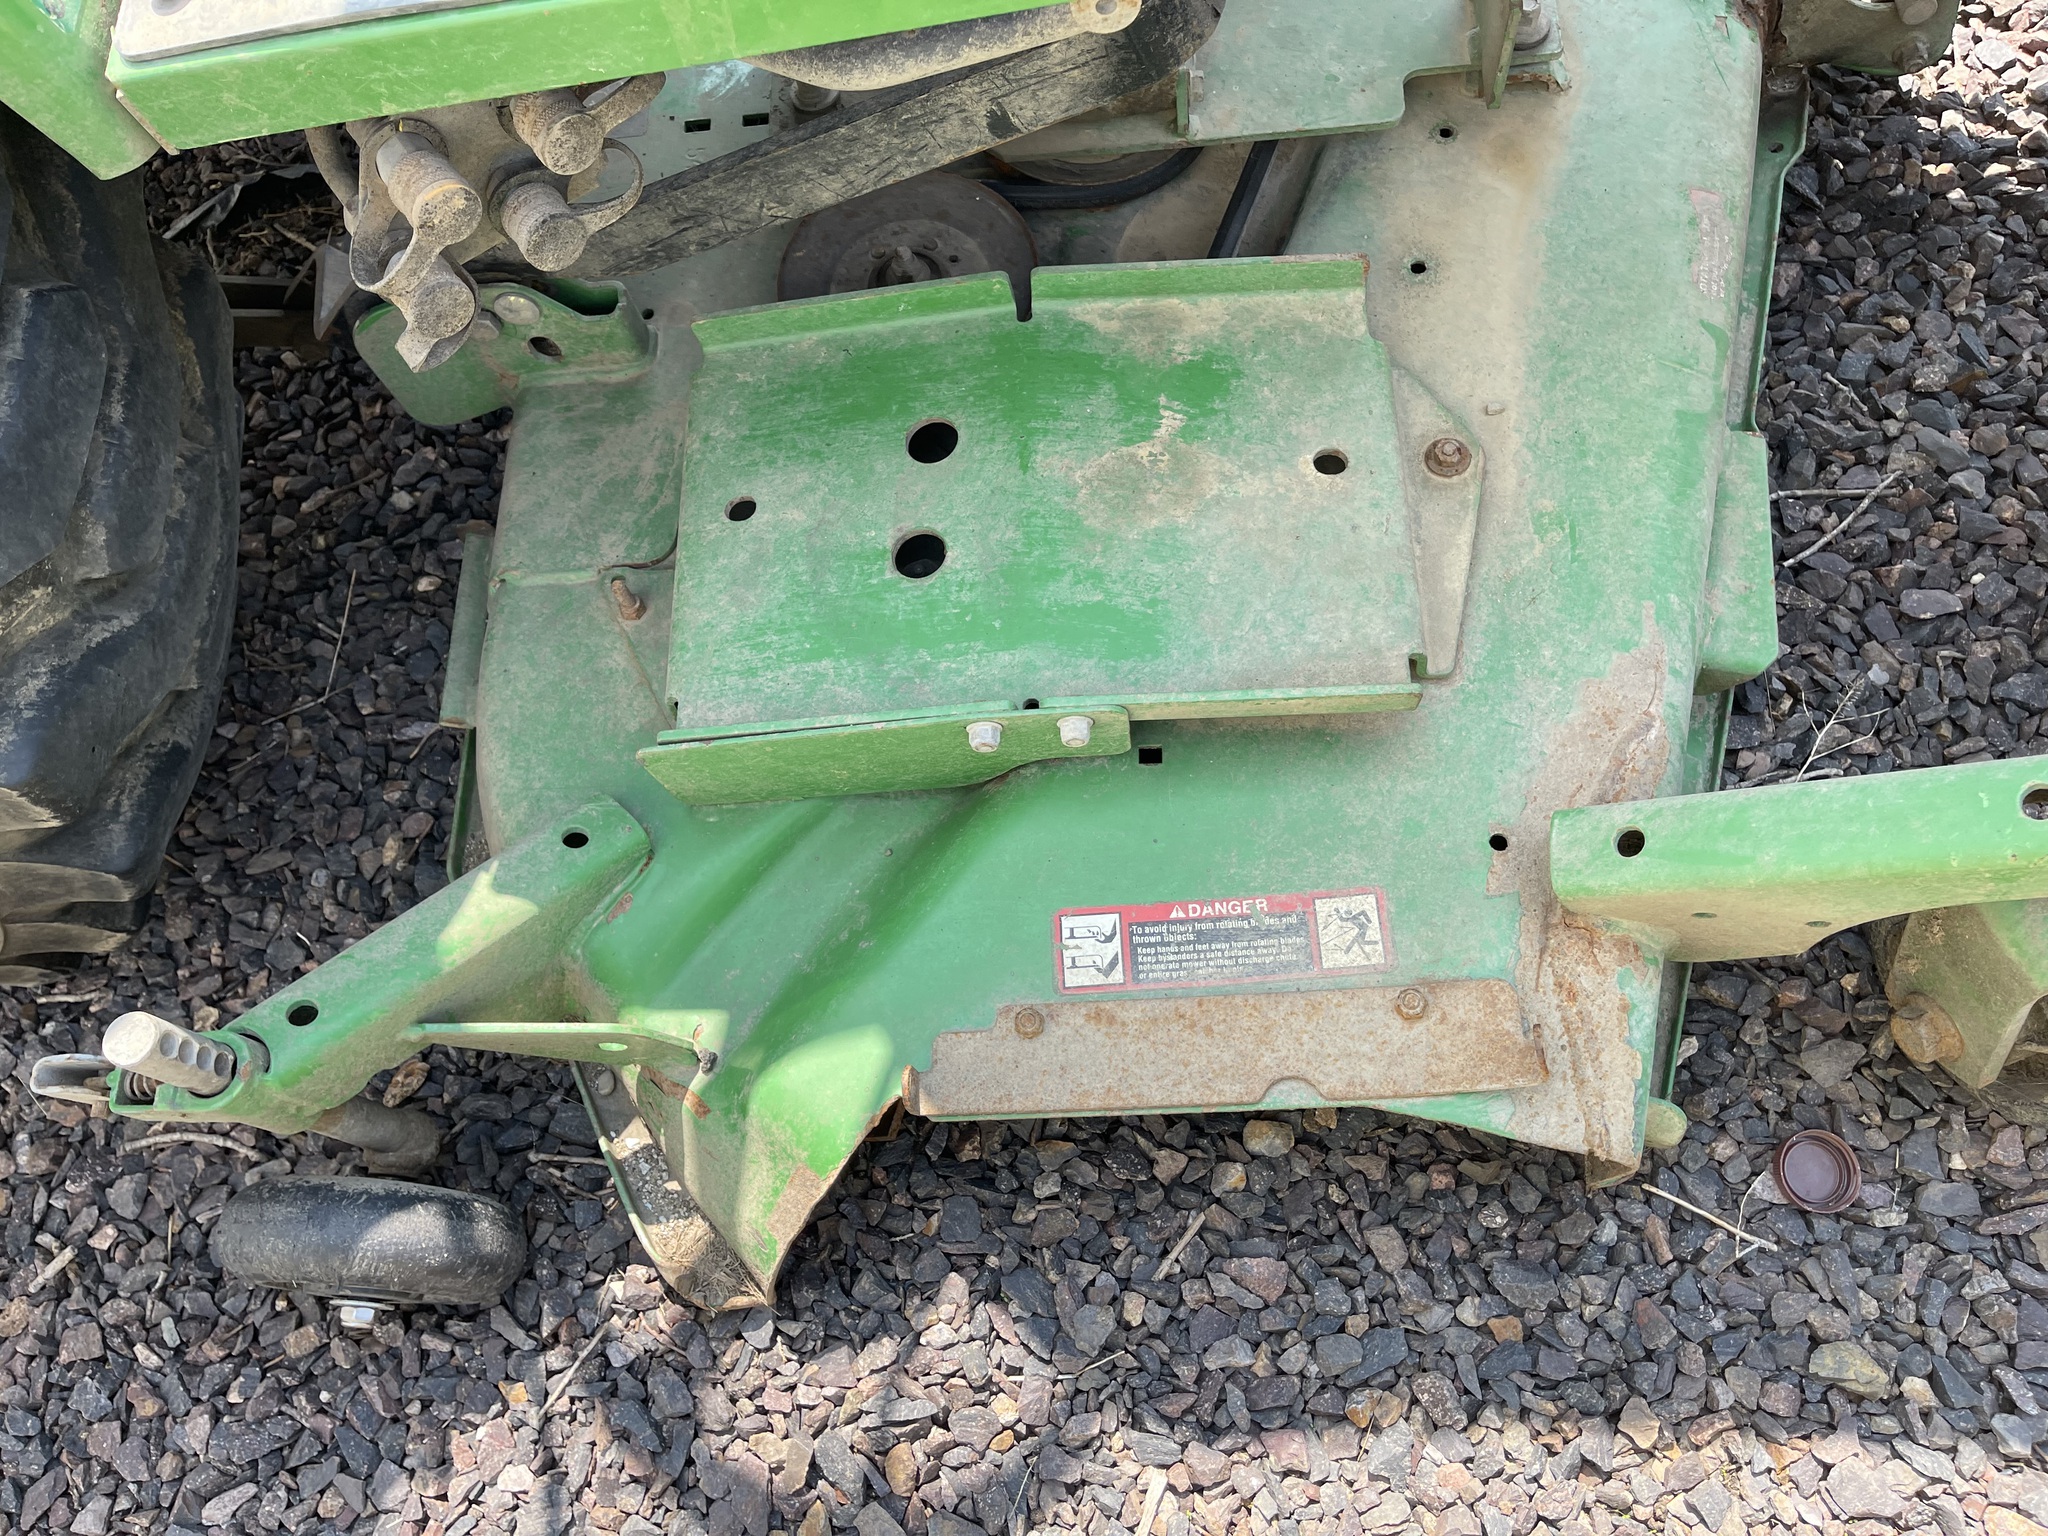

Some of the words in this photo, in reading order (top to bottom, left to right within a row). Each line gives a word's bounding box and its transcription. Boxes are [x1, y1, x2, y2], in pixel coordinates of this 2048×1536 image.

[1188, 898, 1268, 917] DANGER
[1131, 925, 1143, 934] To
[1144, 924, 1167, 934] avoid
[1169, 923, 1193, 933] injury
[1194, 921, 1214, 930] from
[1216, 918, 1249, 930] rotating
[1250, 915, 1280, 926] bdes
[1281, 914, 1297, 924] and
[1132, 934, 1161, 944] thrown
[1137, 946, 1155, 955] Keep
[1157, 945, 1179, 953] hands
[1180, 944, 1193, 952] and
[1195, 943, 1209, 951] feet
[1211, 942, 1230, 951] away
[1232, 940, 1249, 948] from
[1250, 938, 1278, 947] rotating
[1138, 954, 1156, 963] Keep
[1158, 952, 1198, 962] bystanders
[1206, 950, 1222, 958] safe
[1223, 948, 1255, 957] distance
[1138, 963, 1150, 971] not
[1151, 961, 1180, 970] operate
[1181, 959, 1207, 968] mower
[1208, 957, 1236, 966] without
[1237, 954, 1274, 964] discharge
[1139, 972, 1147, 980] or
[1172, 969, 1188, 979] gras
